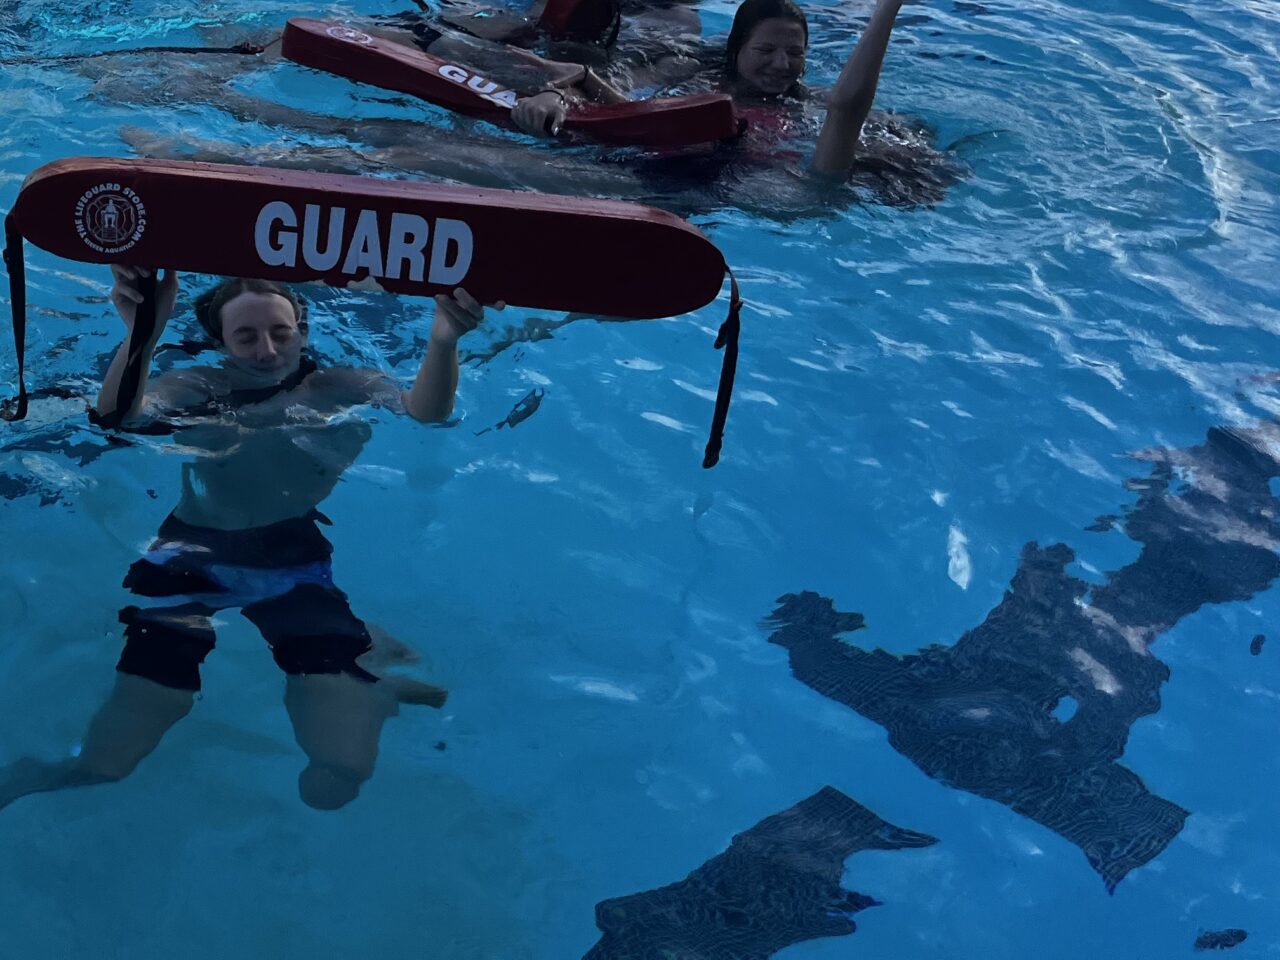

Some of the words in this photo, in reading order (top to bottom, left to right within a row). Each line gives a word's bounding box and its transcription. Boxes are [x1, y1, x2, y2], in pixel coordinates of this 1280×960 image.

[438, 64, 519, 108] GUA
[74, 218, 87, 238] THE
[255, 201, 474, 286] GUARD
